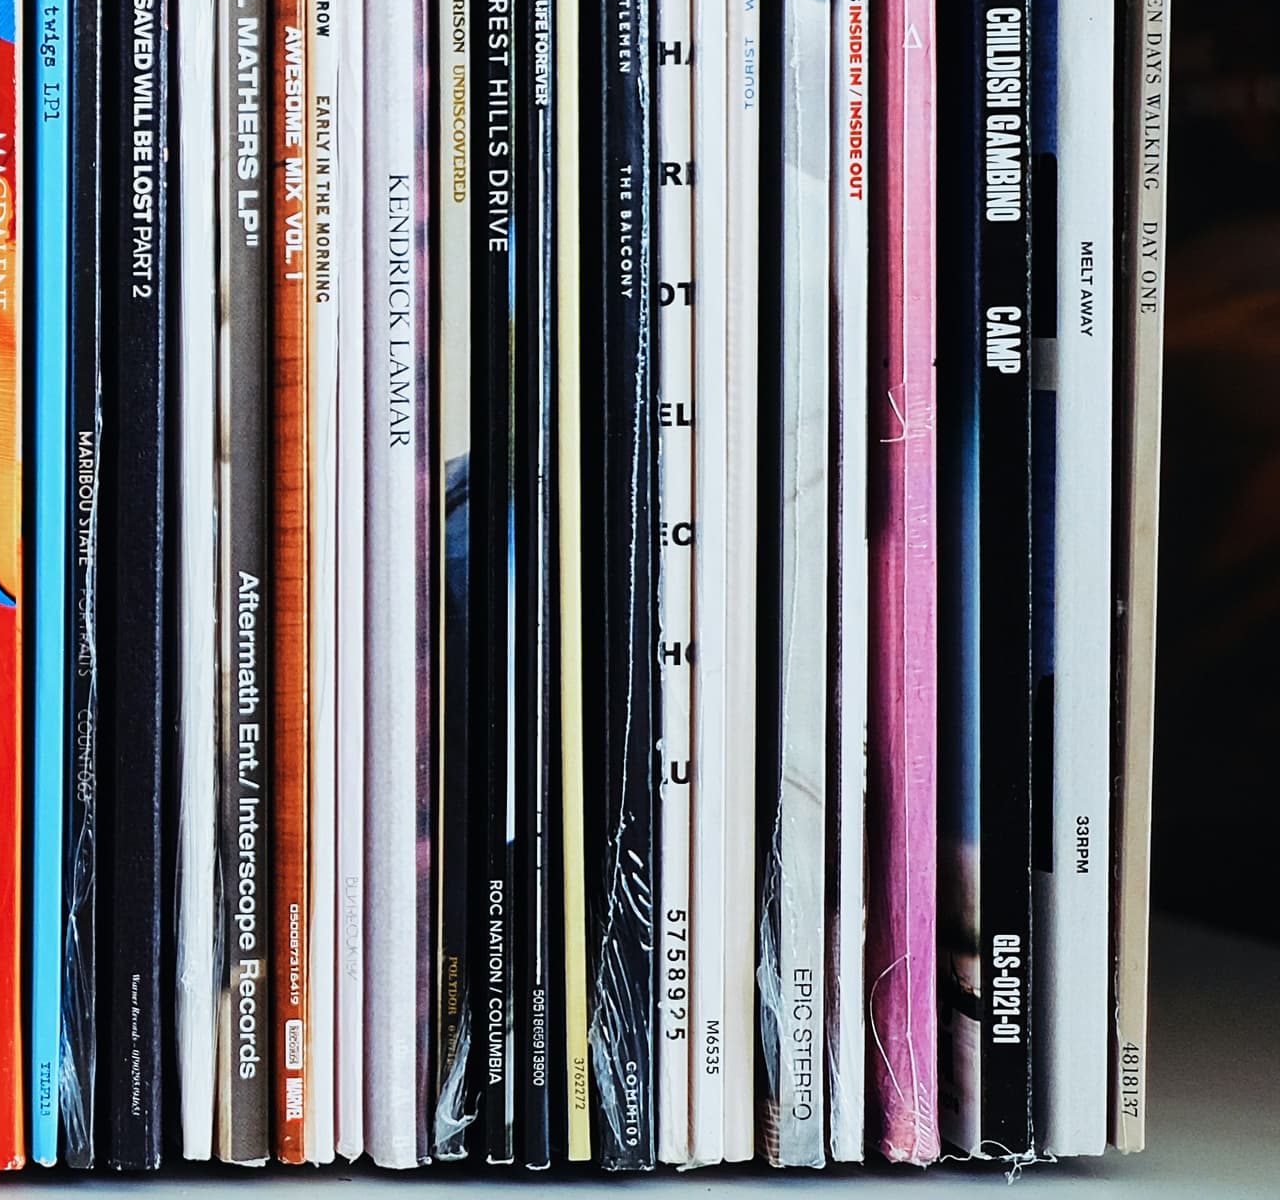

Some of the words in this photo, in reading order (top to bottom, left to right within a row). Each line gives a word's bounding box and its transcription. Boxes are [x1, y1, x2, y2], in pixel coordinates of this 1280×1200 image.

[40, 6, 59, 67] twigs
[986, 8, 1021, 107] CHILDISH
[1146, 33, 1161, 84] DAYS
[44, 83, 59, 122] LP1
[986, 115, 1021, 221] GAMBINO
[1144, 94, 1161, 189] WALKING
[620, 165, 632, 200] THE
[389, 175, 409, 328] KENDRICK
[620, 210, 632, 298] BALCONY
[1081, 242, 1093, 285] MELT
[1142, 222, 1158, 260] DAY
[1081, 289, 1093, 336] AWAY
[1141, 270, 1157, 313] ONE
[986, 306, 1021, 373] CAMP
[390, 341, 409, 447] LAMAR
[239, 571, 259, 715] Aftermath
[235, 798, 259, 950] Interscope
[1076, 816, 1089, 873] 33RPM
[234, 960, 260, 1079] Records
[993, 935, 1020, 1043] GLS-0121-01
[706, 1021, 719, 1074] M6535
[286, 1078, 303, 1120] MARVEL
[574, 1058, 587, 1109] 3762272
